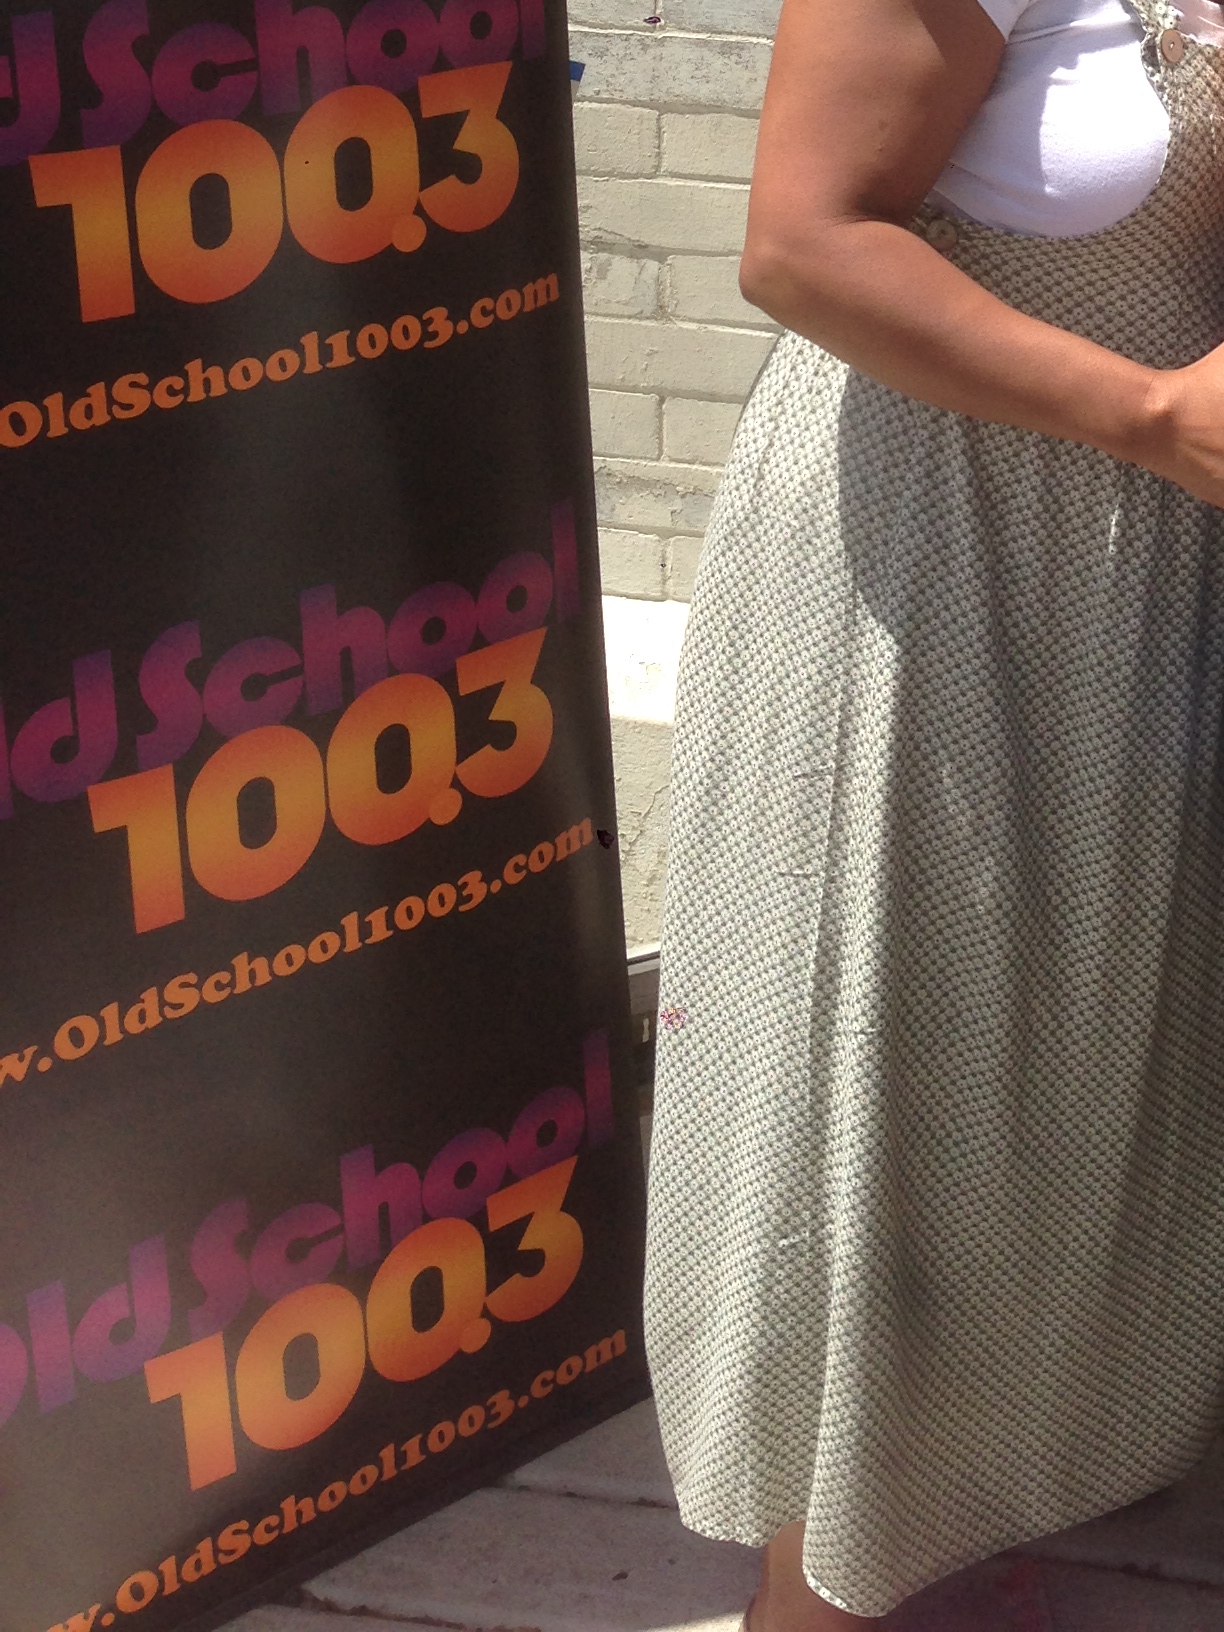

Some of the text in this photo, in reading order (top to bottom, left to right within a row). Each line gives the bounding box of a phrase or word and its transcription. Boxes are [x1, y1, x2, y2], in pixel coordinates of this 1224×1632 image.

[0, 272, 560, 448] OldSchool1003.com
[136, 498, 581, 773] School
[188, 1031, 615, 1344] School
